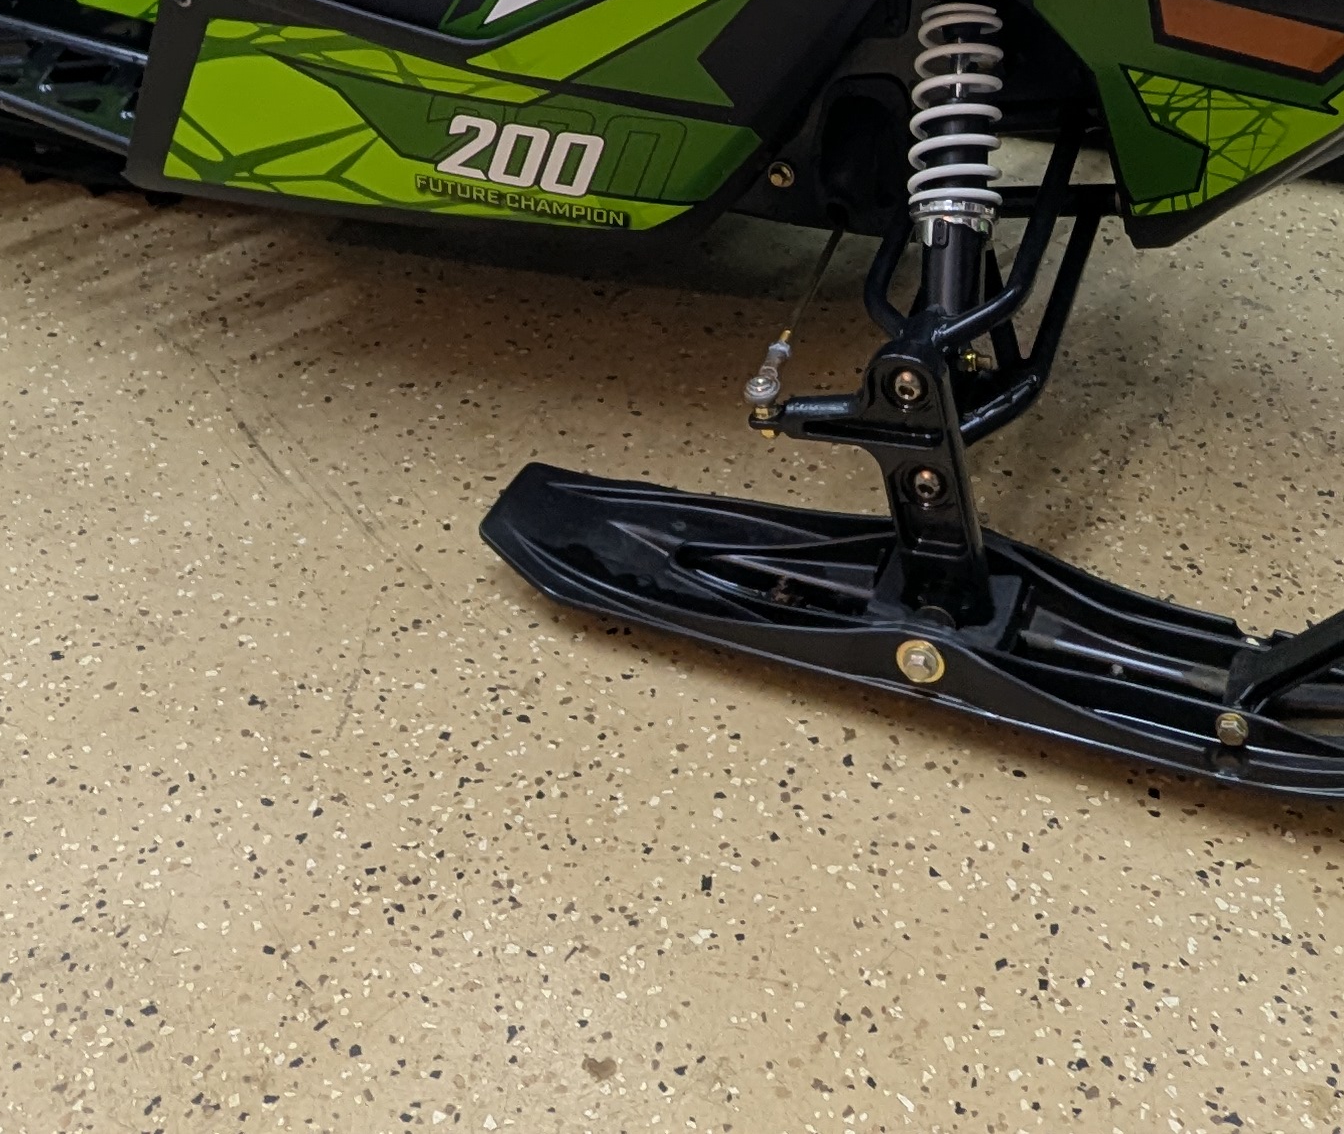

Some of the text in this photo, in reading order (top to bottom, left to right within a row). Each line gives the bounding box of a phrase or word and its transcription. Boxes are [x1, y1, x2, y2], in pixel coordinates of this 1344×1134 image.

[436, 114, 605, 197] 200
[416, 175, 624, 227] FUTURE CHAMPION
